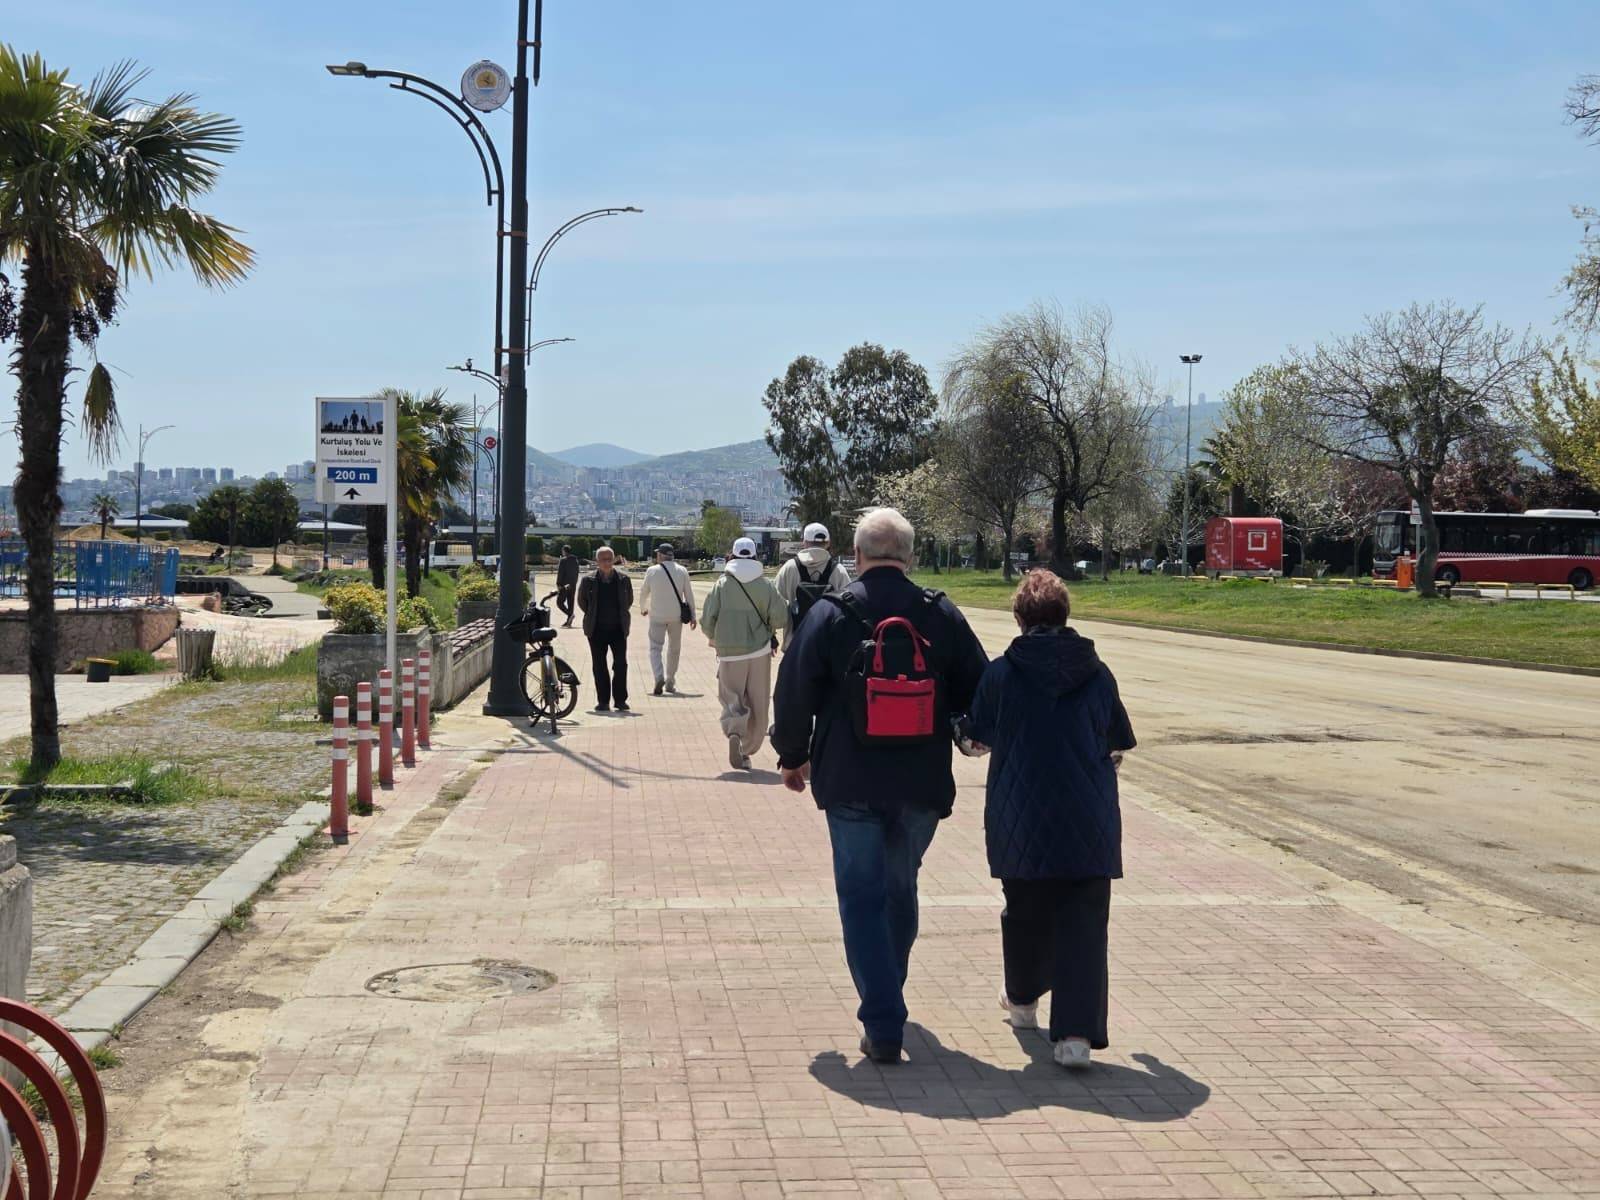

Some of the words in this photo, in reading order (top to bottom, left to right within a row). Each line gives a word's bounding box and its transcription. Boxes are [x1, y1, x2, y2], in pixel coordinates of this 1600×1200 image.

[320, 437, 353, 447] Kurtuluş
[354, 438, 371, 446] Yolu
[372, 438, 383, 446] Ve
[336, 447, 366, 456] İskelesi
[335, 470, 356, 480] 200
[359, 472, 370, 481] m
